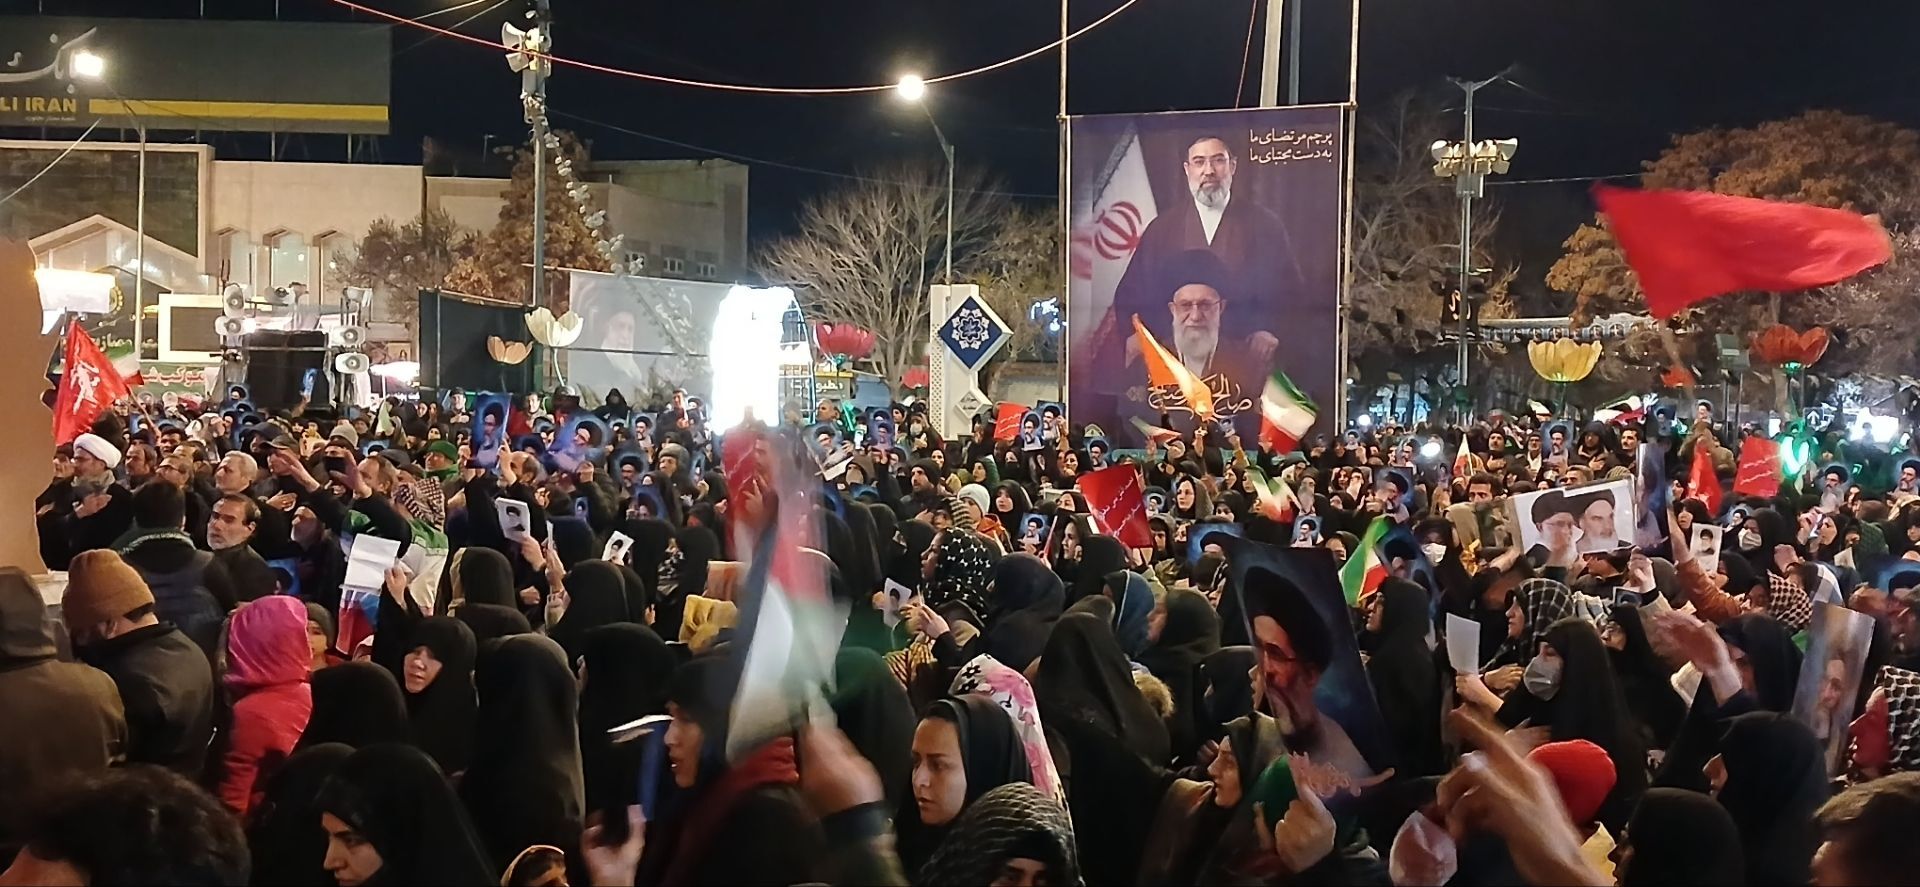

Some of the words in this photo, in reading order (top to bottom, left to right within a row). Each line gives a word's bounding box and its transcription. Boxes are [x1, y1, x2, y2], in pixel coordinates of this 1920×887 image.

[25, 96, 77, 113] IRAN
[1249, 129, 1259, 142] ما
[1259, 128, 1307, 145] مرتضای
[1307, 132, 1333, 149] پرچم
[1249, 147, 1259, 161] ما
[1292, 150, 1321, 160] دست
[1321, 149, 1333, 163] به
